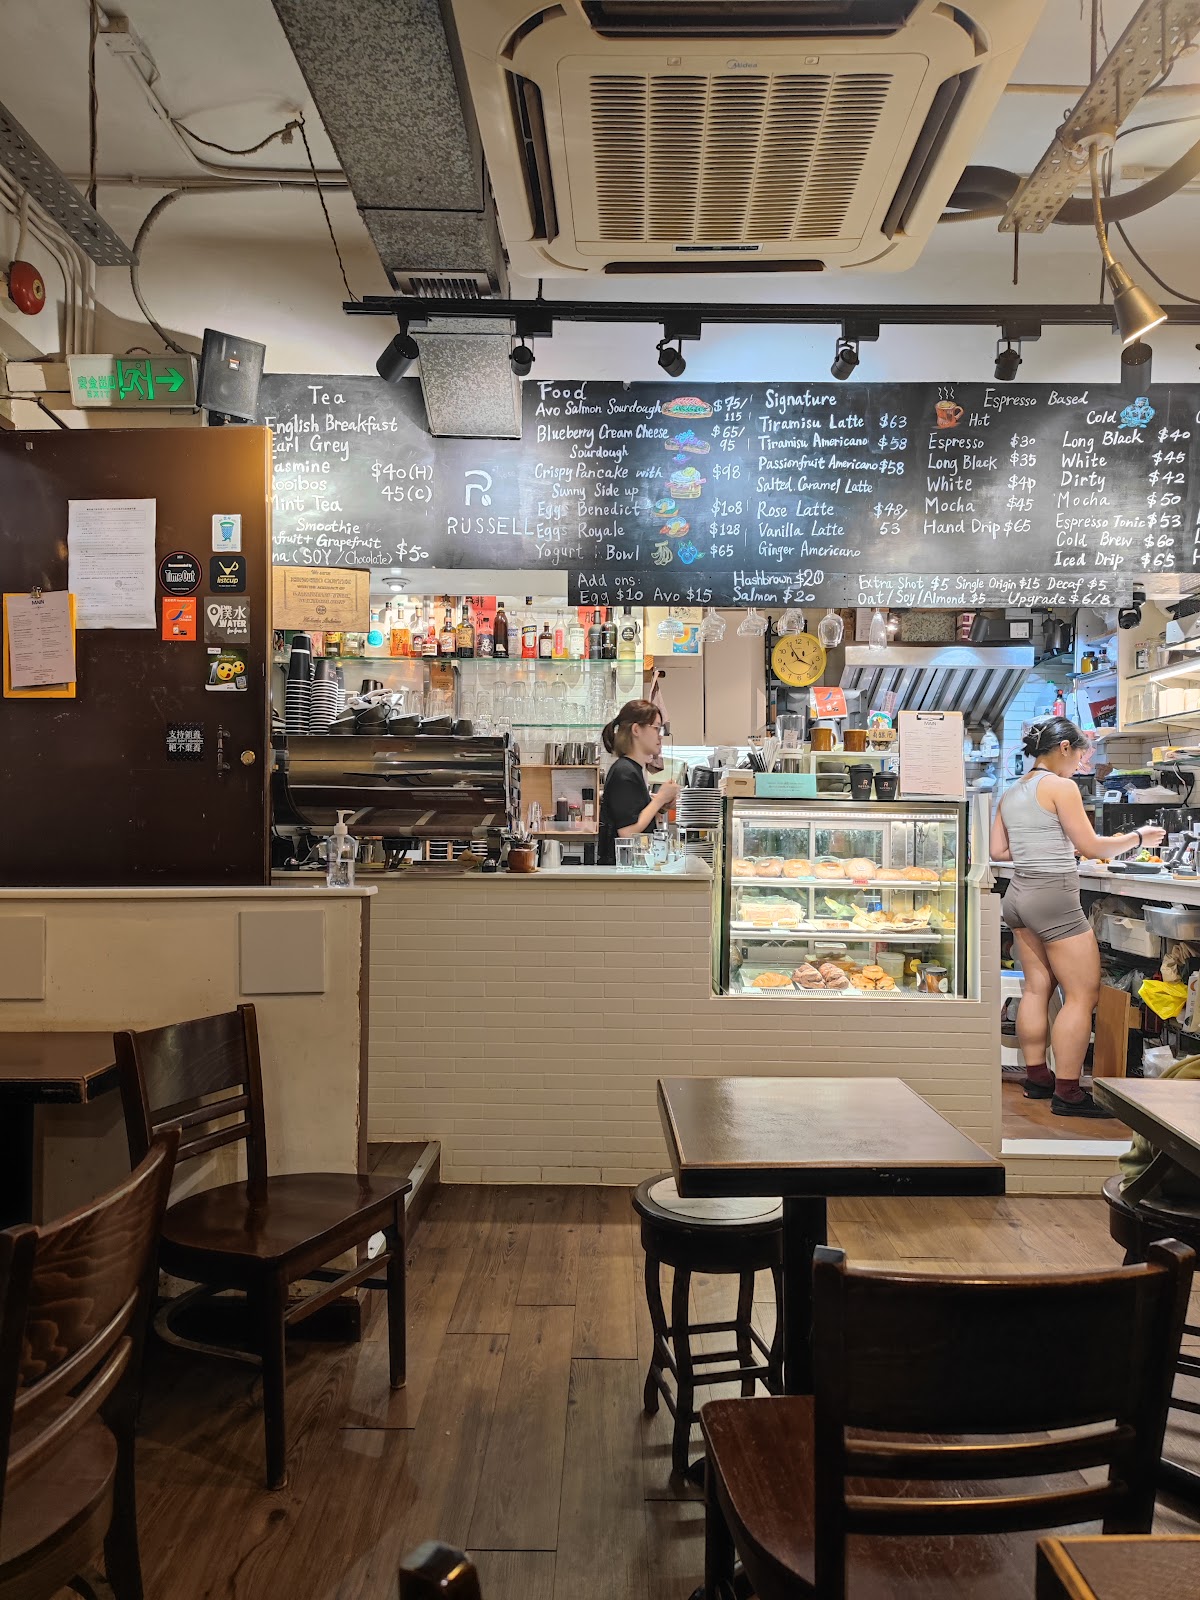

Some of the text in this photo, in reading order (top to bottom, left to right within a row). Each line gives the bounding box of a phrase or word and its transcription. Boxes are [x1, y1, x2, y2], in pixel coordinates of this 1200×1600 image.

[77, 375, 116, 389] 安全出口
[536, 381, 587, 400] Food
[87, 390, 110, 398] EXIT
[307, 385, 346, 405] Tea
[766, 389, 837, 414] Signature
[984, 388, 1089, 412] Espresso Based
[535, 402, 561, 417] Avo
[565, 400, 602, 416] Salmon
[607, 398, 662, 420] Sourdough
[724, 412, 742, 422] 115
[1086, 410, 1117, 424] Cold
[265, 413, 398, 441] English Breakfast
[758, 413, 908, 433] Tiramisu Latte $63
[969, 413, 991, 427] Hot
[536, 424, 594, 449] Blueberry
[598, 424, 634, 440] Cream
[635, 424, 669, 440] Cheese
[719, 439, 736, 452] 95
[757, 432, 908, 451] Tiramisu Americano $58
[928, 432, 1036, 452] Espresso $30
[1063, 427, 1191, 453] Long Black $40
[310, 434, 349, 461] Grey
[569, 444, 629, 464] Sourdough
[272, 456, 330, 474] asmine
[758, 454, 905, 475] Passionfruit Americano $58
[928, 450, 1037, 476] Long Black $35
[1061, 450, 1186, 469] White $45
[534, 463, 573, 484] Crispy
[576, 463, 629, 479] Pancake
[635, 465, 663, 479] with
[712, 463, 741, 480] $98
[1060, 470, 1185, 492] Dirty $42
[551, 482, 639, 501] Sunny Side up
[756, 476, 873, 494] Salted Caramel Latte
[927, 476, 972, 492] White
[312, 495, 343, 511] Tea
[381, 486, 432, 503] 45(C)
[1057, 492, 1182, 509] Mocha $50
[538, 498, 743, 518] Eggs Benedict $108
[757, 500, 787, 519] Rose
[796, 500, 834, 517] Latte
[924, 495, 1034, 514] Mocha $45
[296, 517, 361, 534] Smoothie
[447, 516, 535, 535] RUSSELL
[758, 520, 901, 538] Vanilla Latte 53
[923, 519, 1031, 540] Hand Drip $65
[1055, 512, 1182, 532] Espresso Tonic $53
[537, 522, 740, 542] Eggs Royale $128
[1056, 531, 1175, 549] Cold Brew $60
[316, 533, 381, 551] Grapefruit
[396, 538, 429, 562] $50
[758, 540, 861, 562] Ginger Americano
[534, 543, 734, 565] Yogurt Bowl $65
[1054, 550, 1175, 570] Iced Drip $65
[577, 573, 607, 587] Add
[795, 569, 825, 587] $20
[858, 574, 1108, 594] Extra Shot $5 Single Origin $15 Decaf $5
[579, 588, 712, 606] Egg $10 Avo $15
[732, 587, 816, 604] Salmon $20
[969, 593, 986, 604] $5
[1008, 593, 1066, 608] Upgrade
[218, 620, 247, 628] WATER
